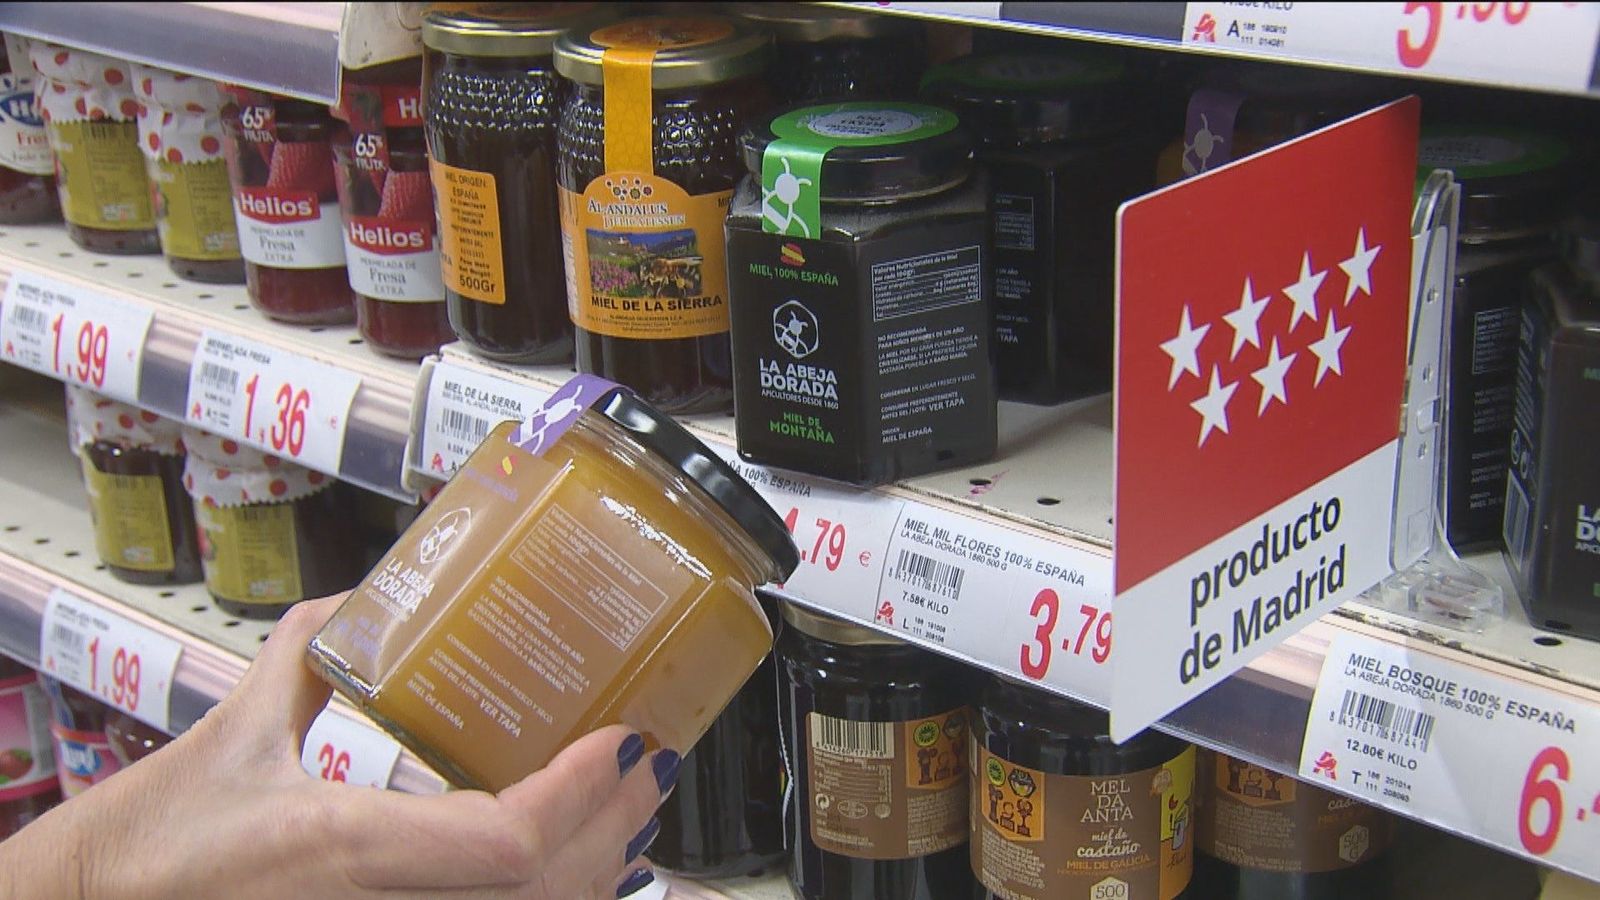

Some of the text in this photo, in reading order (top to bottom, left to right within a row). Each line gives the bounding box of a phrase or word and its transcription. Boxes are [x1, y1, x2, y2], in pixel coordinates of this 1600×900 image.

[1227, 20, 1239, 37] A
[240, 191, 313, 216] Helios
[259, 234, 296, 251] Fresa
[350, 220, 425, 247] Helios
[369, 268, 406, 285] Fresa
[459, 275, 496, 294] 500Gr
[749, 263, 839, 287] MIEL 100% ESPAÑA
[591, 296, 723, 312] MIEL DE LA SIERRA
[52, 313, 107, 387] 1.99
[759, 358, 838, 385] LA ABEJA
[444, 380, 462, 394] MIEL
[464, 386, 476, 399] DE
[478, 392, 489, 403] LA
[490, 395, 521, 412] SIERRA
[760, 373, 838, 400] DORADA
[761, 388, 839, 410] APICULTORES DESDE 1860
[245, 374, 310, 457] 1.36
[927, 400, 945, 412] VER
[945, 395, 965, 408] TAPA
[770, 420, 835, 444] MONTAÑA
[783, 412, 822, 430] MIEL DE
[881, 425, 933, 444] MIEL DE ESPAÑA
[744, 468, 812, 498] 100% ESPAÑA
[900, 530, 1008, 571] LA ABEJA DORADA 1860 500 G
[904, 518, 1086, 588] MIEL MIL FLORES 100% ESPAÑA
[1190, 497, 1341, 627] producto
[384, 557, 435, 598] LA ABEJA
[372, 570, 424, 614] DORADA
[902, 590, 949, 615] 7.58€ KILO
[902, 617, 909, 630] L
[1179, 543, 1346, 685] de Madrid
[1020, 588, 1113, 681] 3.79
[86, 636, 141, 711] 1.99
[405, 677, 467, 730] MIEL DE ESPAÑA
[1344, 666, 1495, 721] LA ABEJA DORADA 1860 500 G
[1348, 653, 1576, 734] MIEL BOSQUE 100% ESPAÑA
[477, 697, 501, 720] VER
[494, 711, 524, 739] TAPA
[1346, 739, 1418, 771] 12.80€ KILO
[1090, 780, 1131, 796] MEL
[1352, 770, 1361, 785] T
[1097, 794, 1125, 809] DA
[1519, 746, 1600, 856] 6.
[1080, 806, 1134, 823] ANTA
[1091, 828, 1128, 842] miel de
[1066, 853, 1151, 870] MIEL DE GALICIA
[1077, 840, 1141, 858] castaño
[1095, 884, 1126, 899] 500
